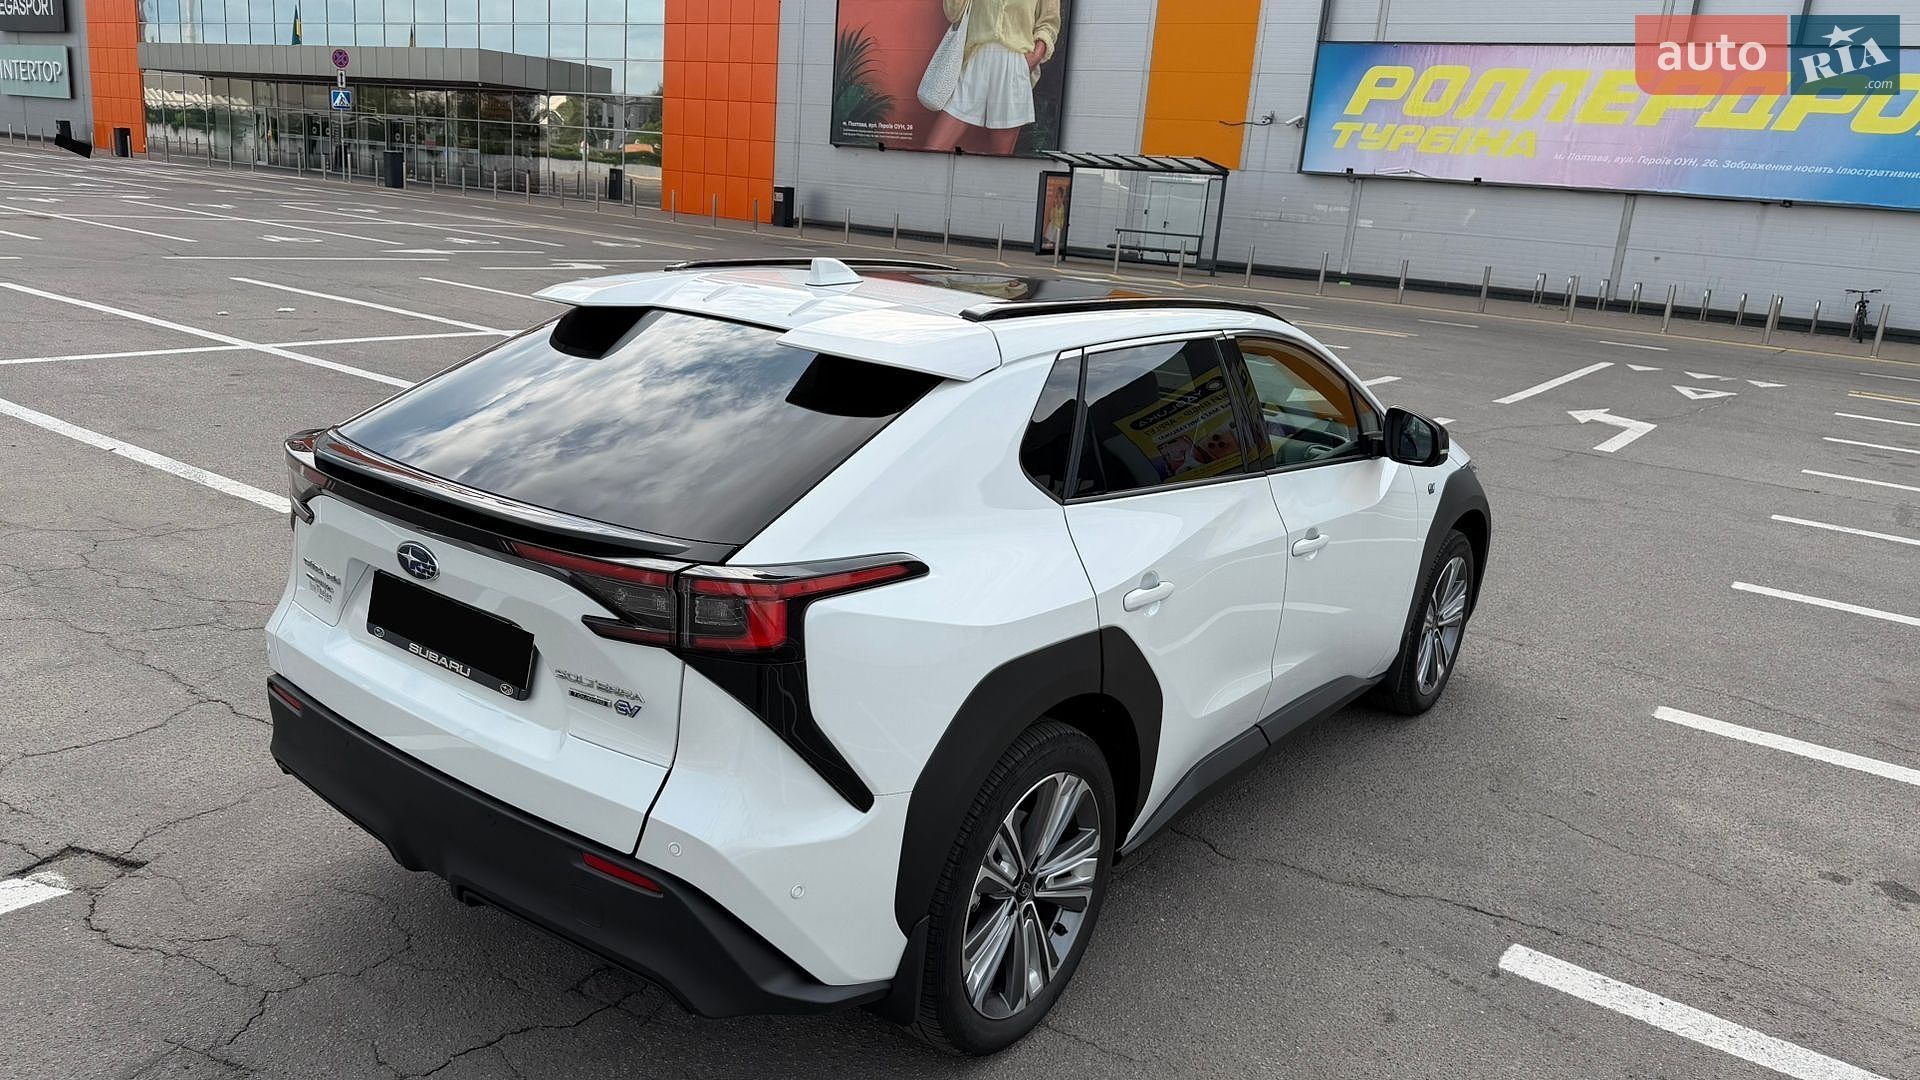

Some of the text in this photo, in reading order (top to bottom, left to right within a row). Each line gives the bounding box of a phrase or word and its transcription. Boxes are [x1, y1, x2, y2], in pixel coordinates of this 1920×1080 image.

[1343, 65, 1920, 135] РОЛЛЕРДРО
[1332, 123, 1537, 158] ТУРБІНА
[1567, 152, 1611, 163] Полтава,
[1638, 156, 1671, 166] Героїв
[1674, 158, 1698, 167] ОУН,
[1722, 160, 1792, 171] Зображення
[1793, 165, 1834, 174] носить
[1836, 166, 1920, 179] ілюстративни
[409, 643, 471, 677] SUBARU
